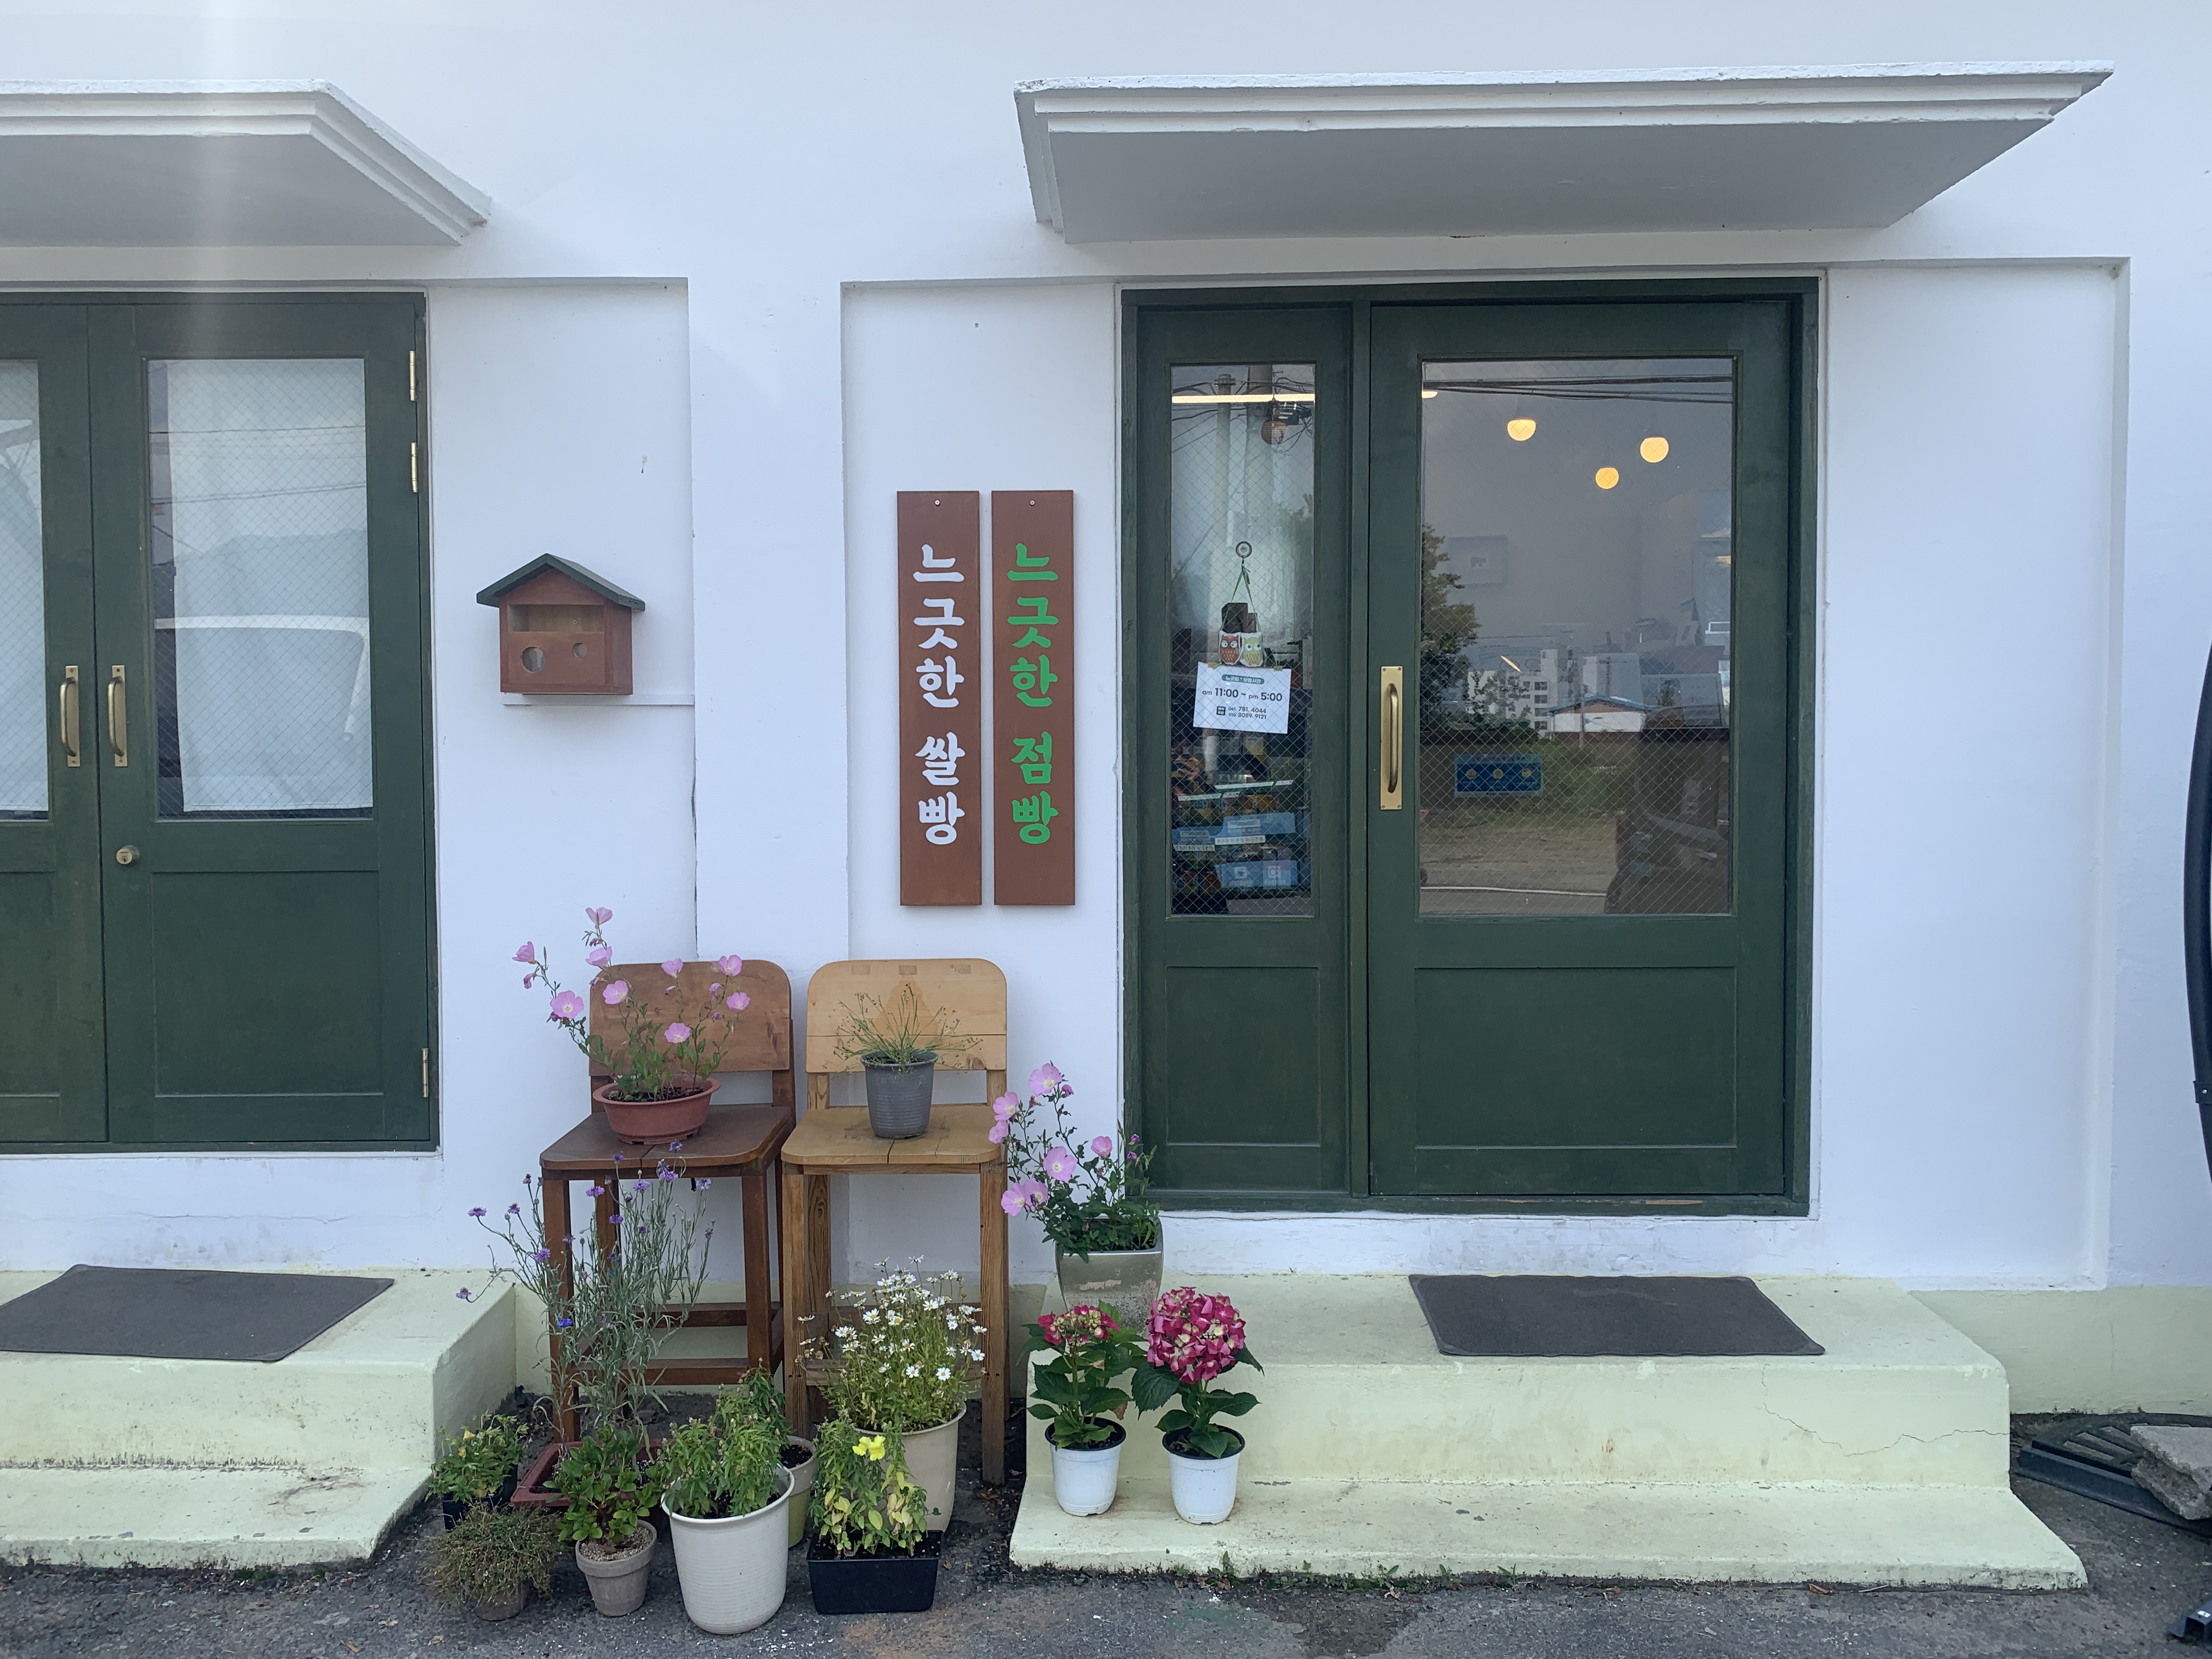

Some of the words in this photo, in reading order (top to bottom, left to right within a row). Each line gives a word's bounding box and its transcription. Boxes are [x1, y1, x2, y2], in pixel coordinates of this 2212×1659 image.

[913, 544, 964, 708] 느긋한
[1007, 543, 1059, 708] 느긋한
[1215, 687, 1239, 698] 11:00
[1261, 692, 1283, 702] 5:00
[915, 731, 966, 845] 쌀빵
[1011, 731, 1059, 845] 점빵
